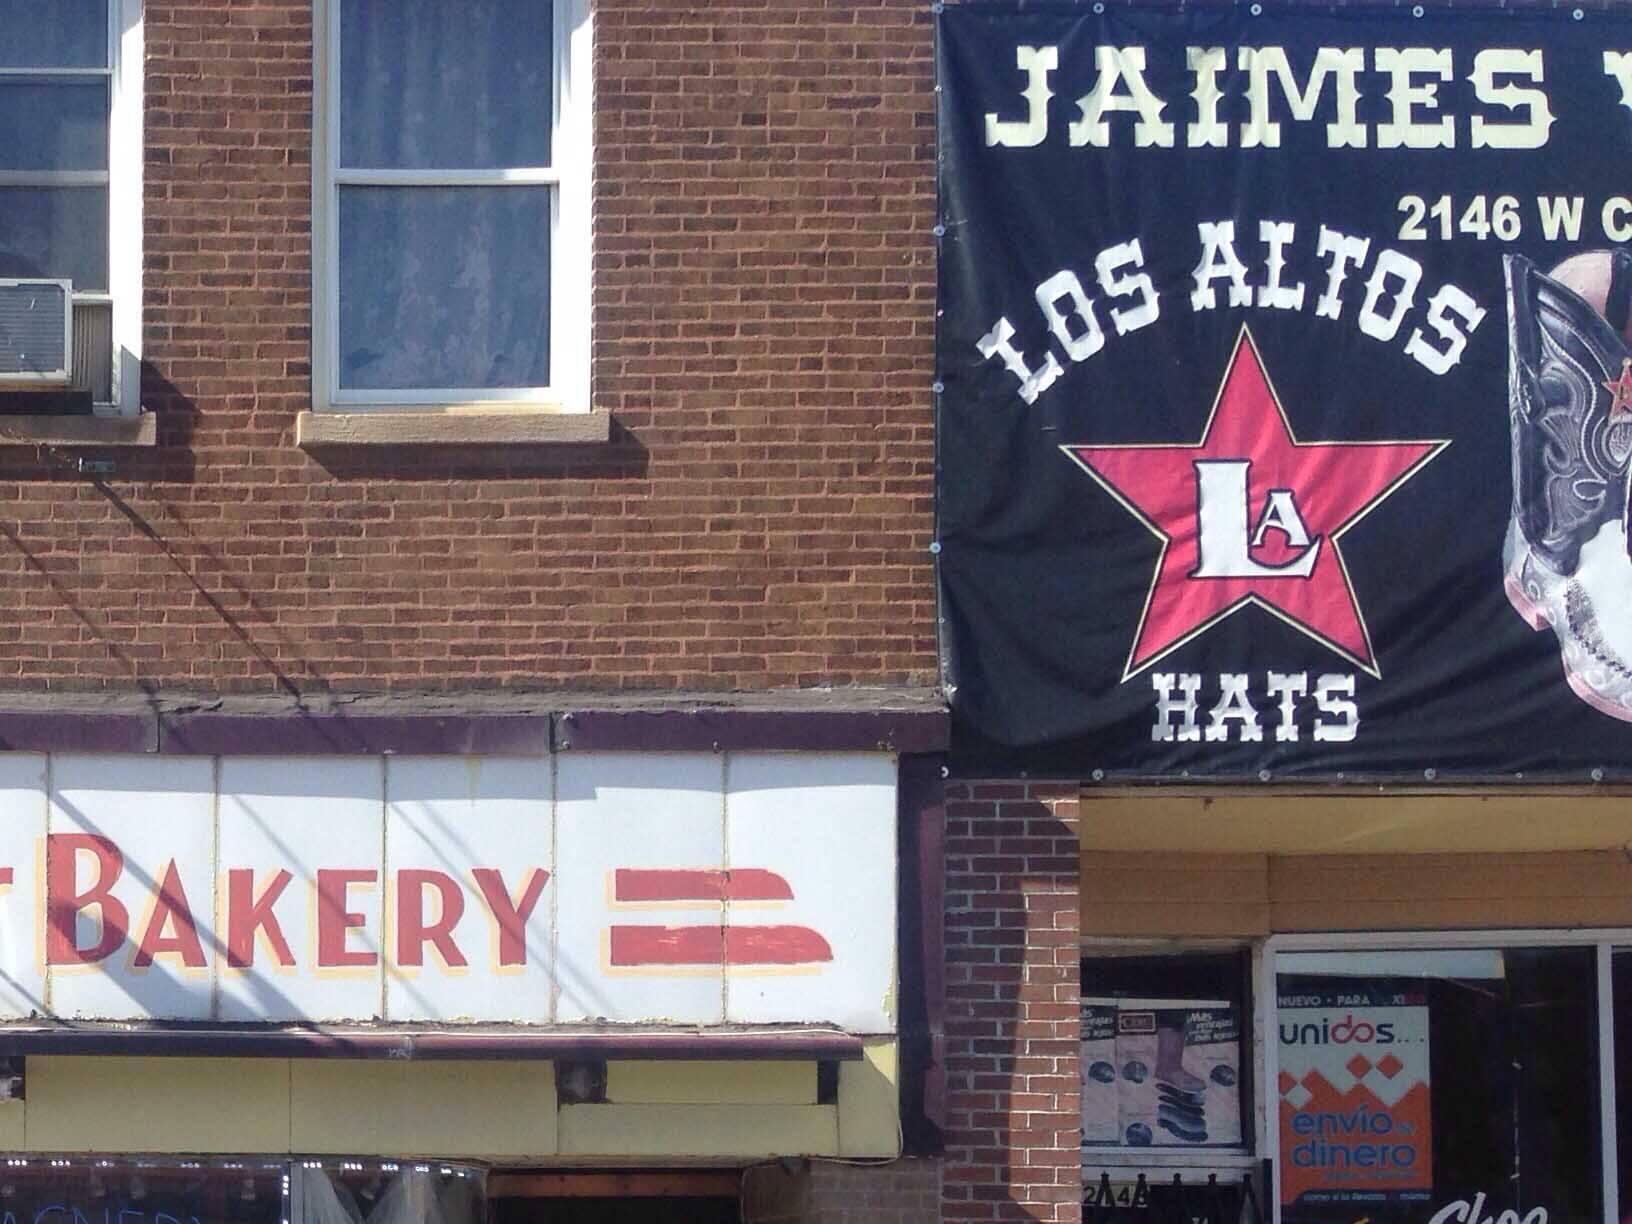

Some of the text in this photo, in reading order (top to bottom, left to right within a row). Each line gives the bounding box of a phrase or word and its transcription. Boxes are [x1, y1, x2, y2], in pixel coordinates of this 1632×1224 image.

[985, 46, 1557, 149] JAIMES
[1397, 195, 1521, 241] 2146
[1537, 196, 1585, 241] W
[976, 220, 1486, 405] LOS ALTOS
[1152, 671, 1361, 742] HATS
[39, 832, 551, 968] BAKERY
[1292, 1105, 1393, 1134] envío
[1292, 1140, 1416, 1168] dinero
